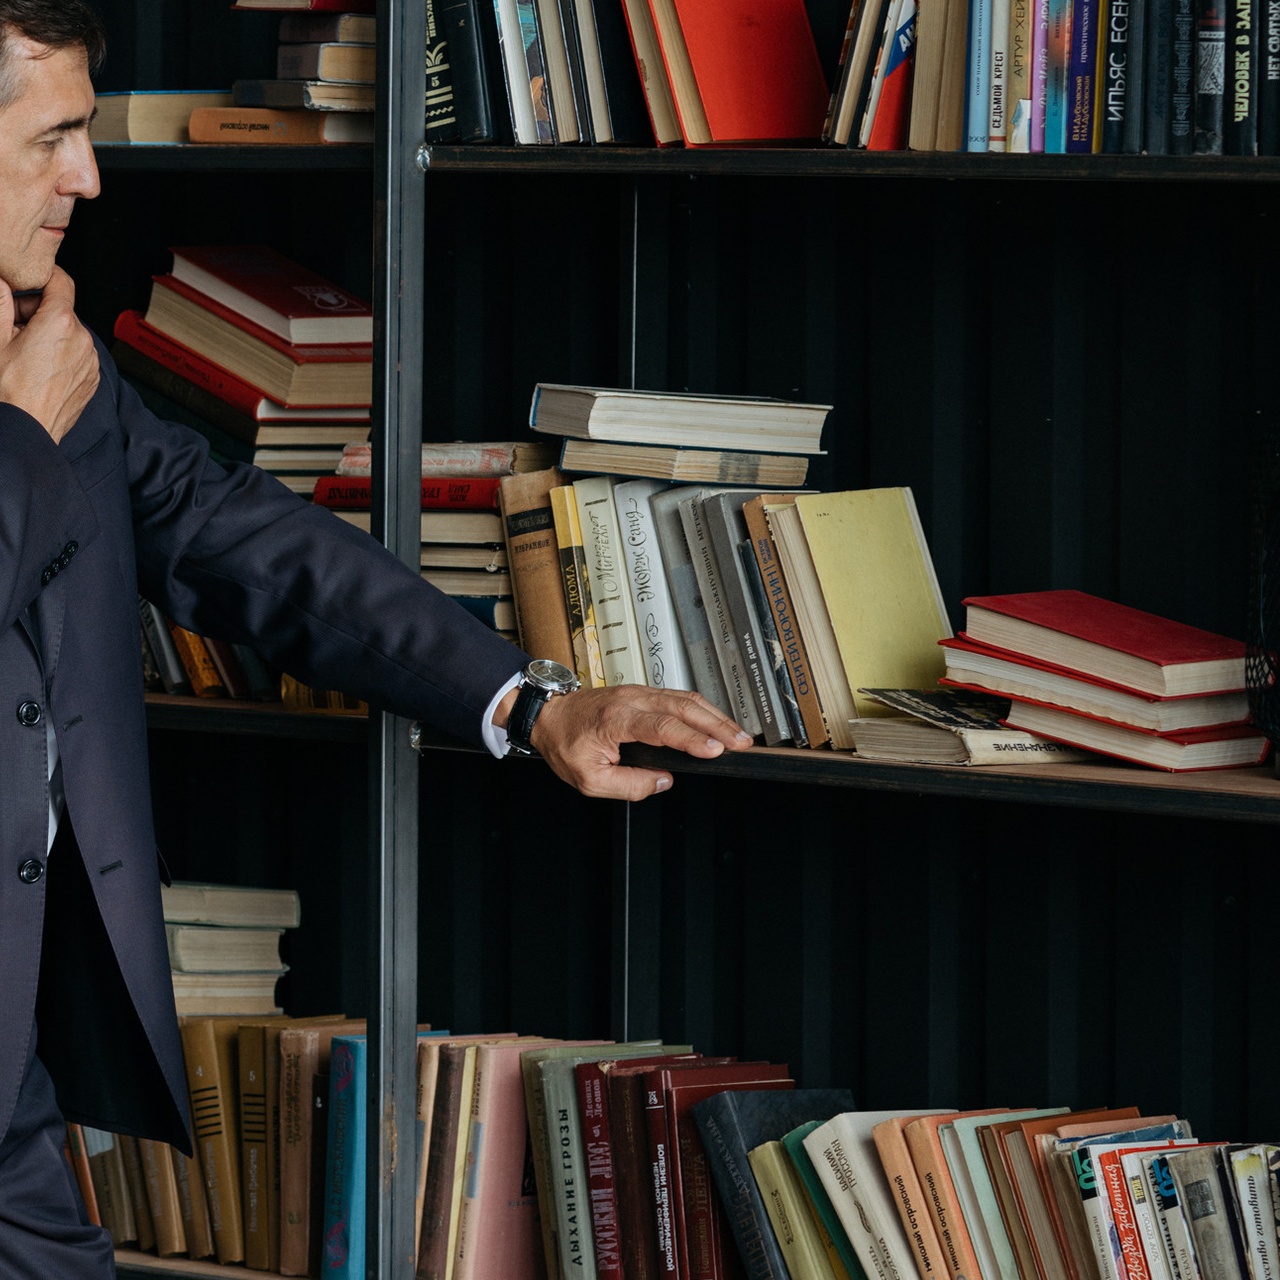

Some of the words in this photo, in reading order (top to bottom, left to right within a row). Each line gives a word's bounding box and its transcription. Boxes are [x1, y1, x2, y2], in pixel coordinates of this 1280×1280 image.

[1080, 5, 1090, 63] практическое
[1236, 35, 1250, 45] В
[1268, 1, 1280, 51] СВЯТЫХ
[994, 51, 1004, 79] КРЕСТ
[1015, 34, 1024, 77] АРТУР
[1267, 53, 1280, 80] НЕТ
[992, 84, 1003, 129] СЕДЬМОЙ
[1108, 52, 1127, 121] ИЛЬЯС
[1234, 51, 1250, 122] ЧЕЛОВЕК
[625, 497, 647, 547] Санд
[690, 502, 704, 541] МЕТЕОР
[514, 539, 550, 553] ИЗБРАННОЕ
[564, 564, 580, 603] ДЮМА
[634, 547, 655, 602] Жорж
[700, 546, 730, 643] ПРОМЕЛЬКНУВШИЙ
[767, 570, 794, 641] ВОРОНИН
[744, 632, 757, 660] ДЮМА
[785, 642, 809, 695] СЕРГЕЙ
[993, 742, 1073, 754] НАЗНАЧЕНИЕ
[559, 1109, 572, 1169] ГРОЗЫ
[587, 1141, 611, 1179] ЛЕС
[652, 1162, 662, 1204] НЕРВНОЙ
[656, 1144, 668, 1186] БОЛЕЗНИ
[694, 1153, 708, 1212] ЛЕНТА
[823, 1148, 849, 1191] ВАСИЛИЙ
[831, 1139, 856, 1189] ГРОССМАН
[894, 1175, 918, 1229] островский
[925, 1172, 946, 1228] островский
[1105, 1163, 1132, 1231] заветная
[1147, 1165, 1164, 1212] МОСКВА
[1246, 1175, 1263, 1236] готовить
[564, 1177, 582, 1265] ДЫХАНИЕ
[591, 1188, 618, 1270] РУССКИЙ
[656, 1207, 665, 1251] СИСТЕМЫ
[660, 1188, 675, 1271] ПЕРИФЕРИЧЕСКОЙ
[1092, 1215, 1105, 1246] рассказы
[913, 1230, 932, 1272] николай
[942, 1229, 960, 1271] николай
